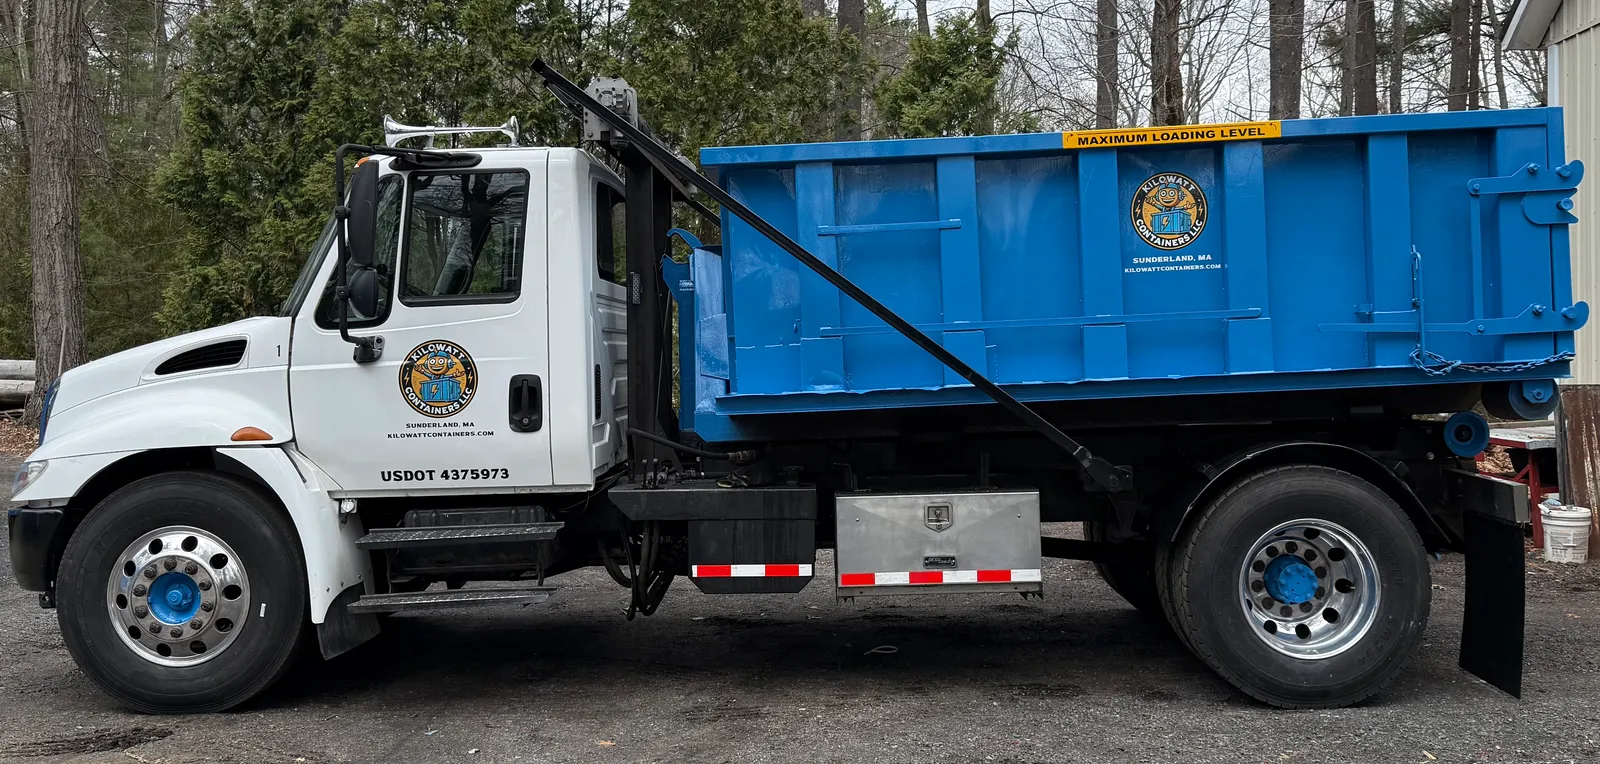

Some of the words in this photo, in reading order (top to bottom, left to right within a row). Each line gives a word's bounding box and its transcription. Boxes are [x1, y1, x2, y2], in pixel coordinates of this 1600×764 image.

[1077, 133, 1148, 146] MAXIMUM
[1152, 130, 1216, 142] LOADING
[1220, 127, 1266, 137] LEVEL
[1141, 175, 1196, 193] KILOWATT
[1135, 218, 1191, 247] CONTAINERS
[1189, 219, 1203, 236] LLC
[1132, 255, 1196, 263] SUNDERLAND,
[1124, 264, 1221, 273] KILOWATTCONTAINERS.COM
[276, 344, 281, 357] 1
[411, 343, 465, 361] KILOWATT
[405, 386, 460, 415] CONTAINERS
[459, 387, 473, 404] LLC
[387, 431, 495, 439] KILOWATTCONTAINERS.COM
[380, 470, 436, 481] USDOT
[440, 468, 510, 480] 4375973
